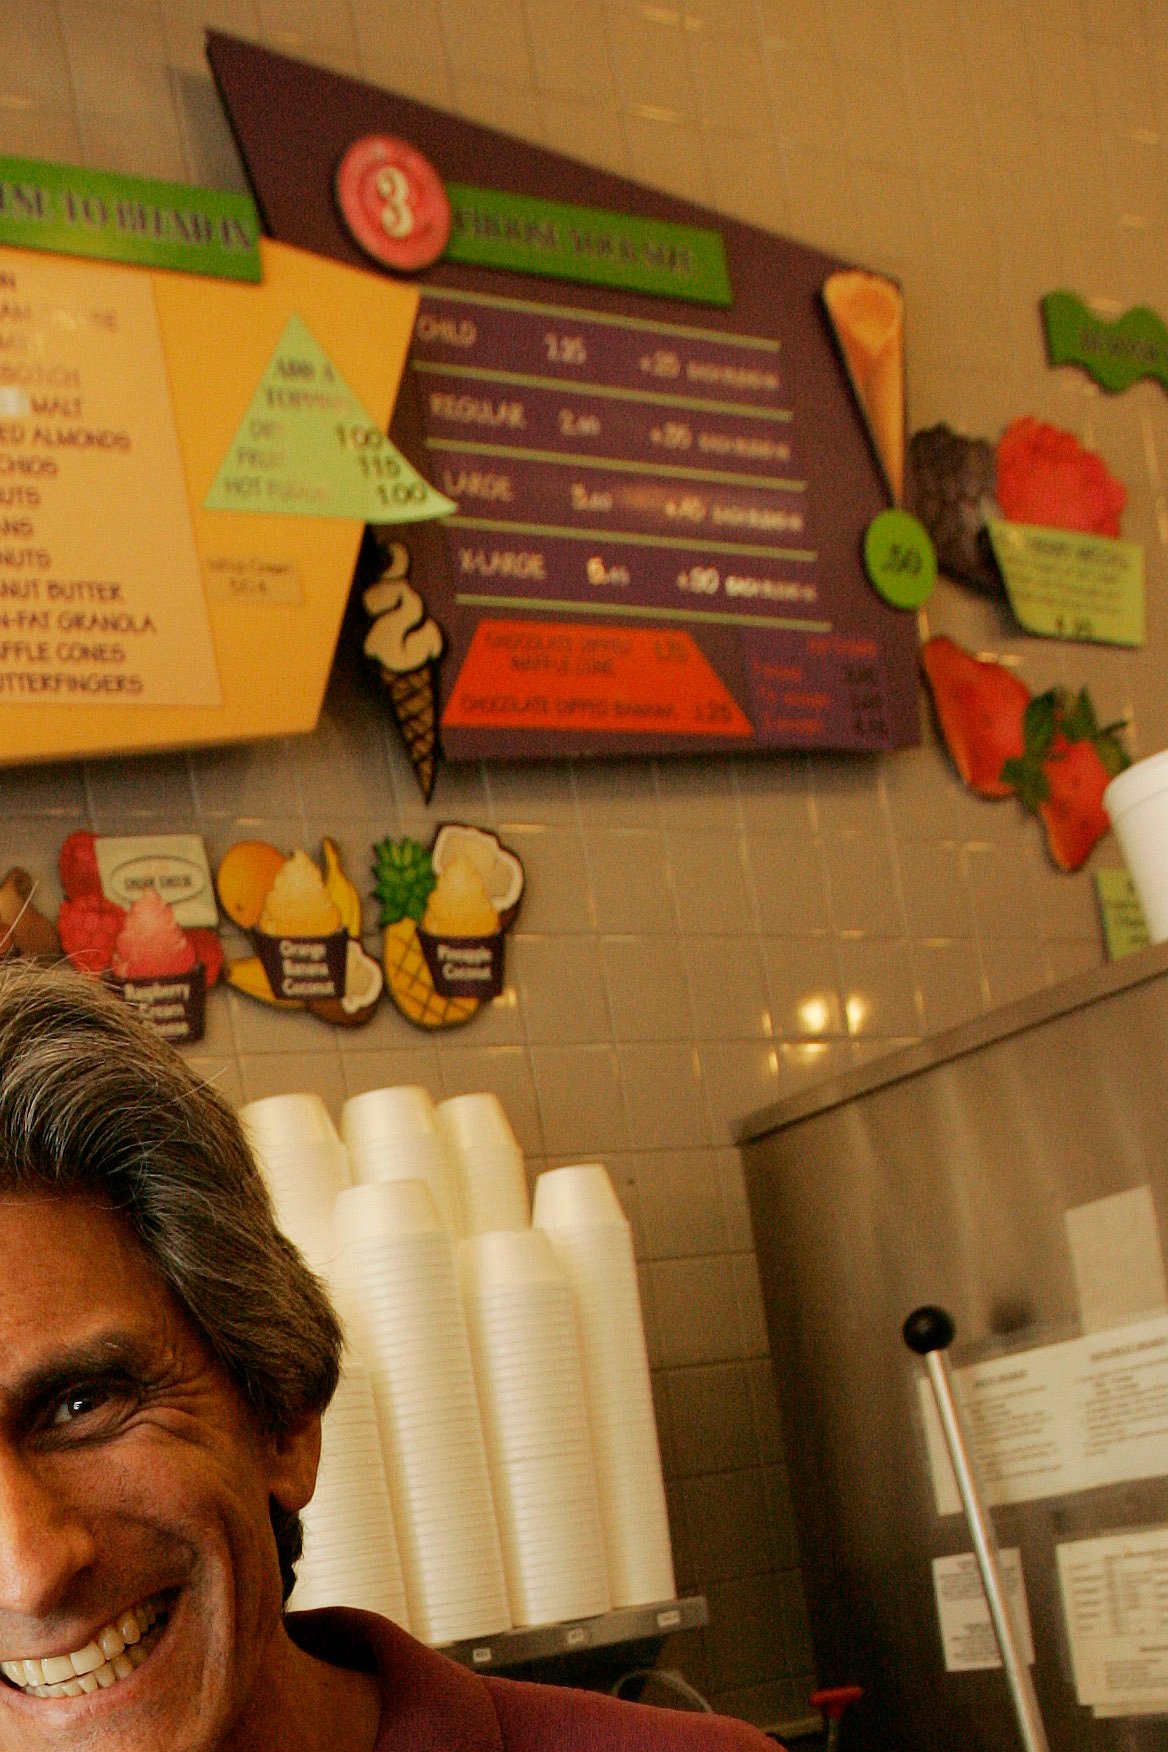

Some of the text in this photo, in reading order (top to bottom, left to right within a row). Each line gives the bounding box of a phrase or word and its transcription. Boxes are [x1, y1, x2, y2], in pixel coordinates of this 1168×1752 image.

[61, 188, 110, 228] TO
[376, 165, 413, 239] 3
[32, 396, 83, 419] MALT
[32, 424, 132, 452] ALMONDS
[47, 581, 125, 604] BUTTER
[57, 611, 157, 635] GRANOLA
[56, 641, 126, 664] CONES
